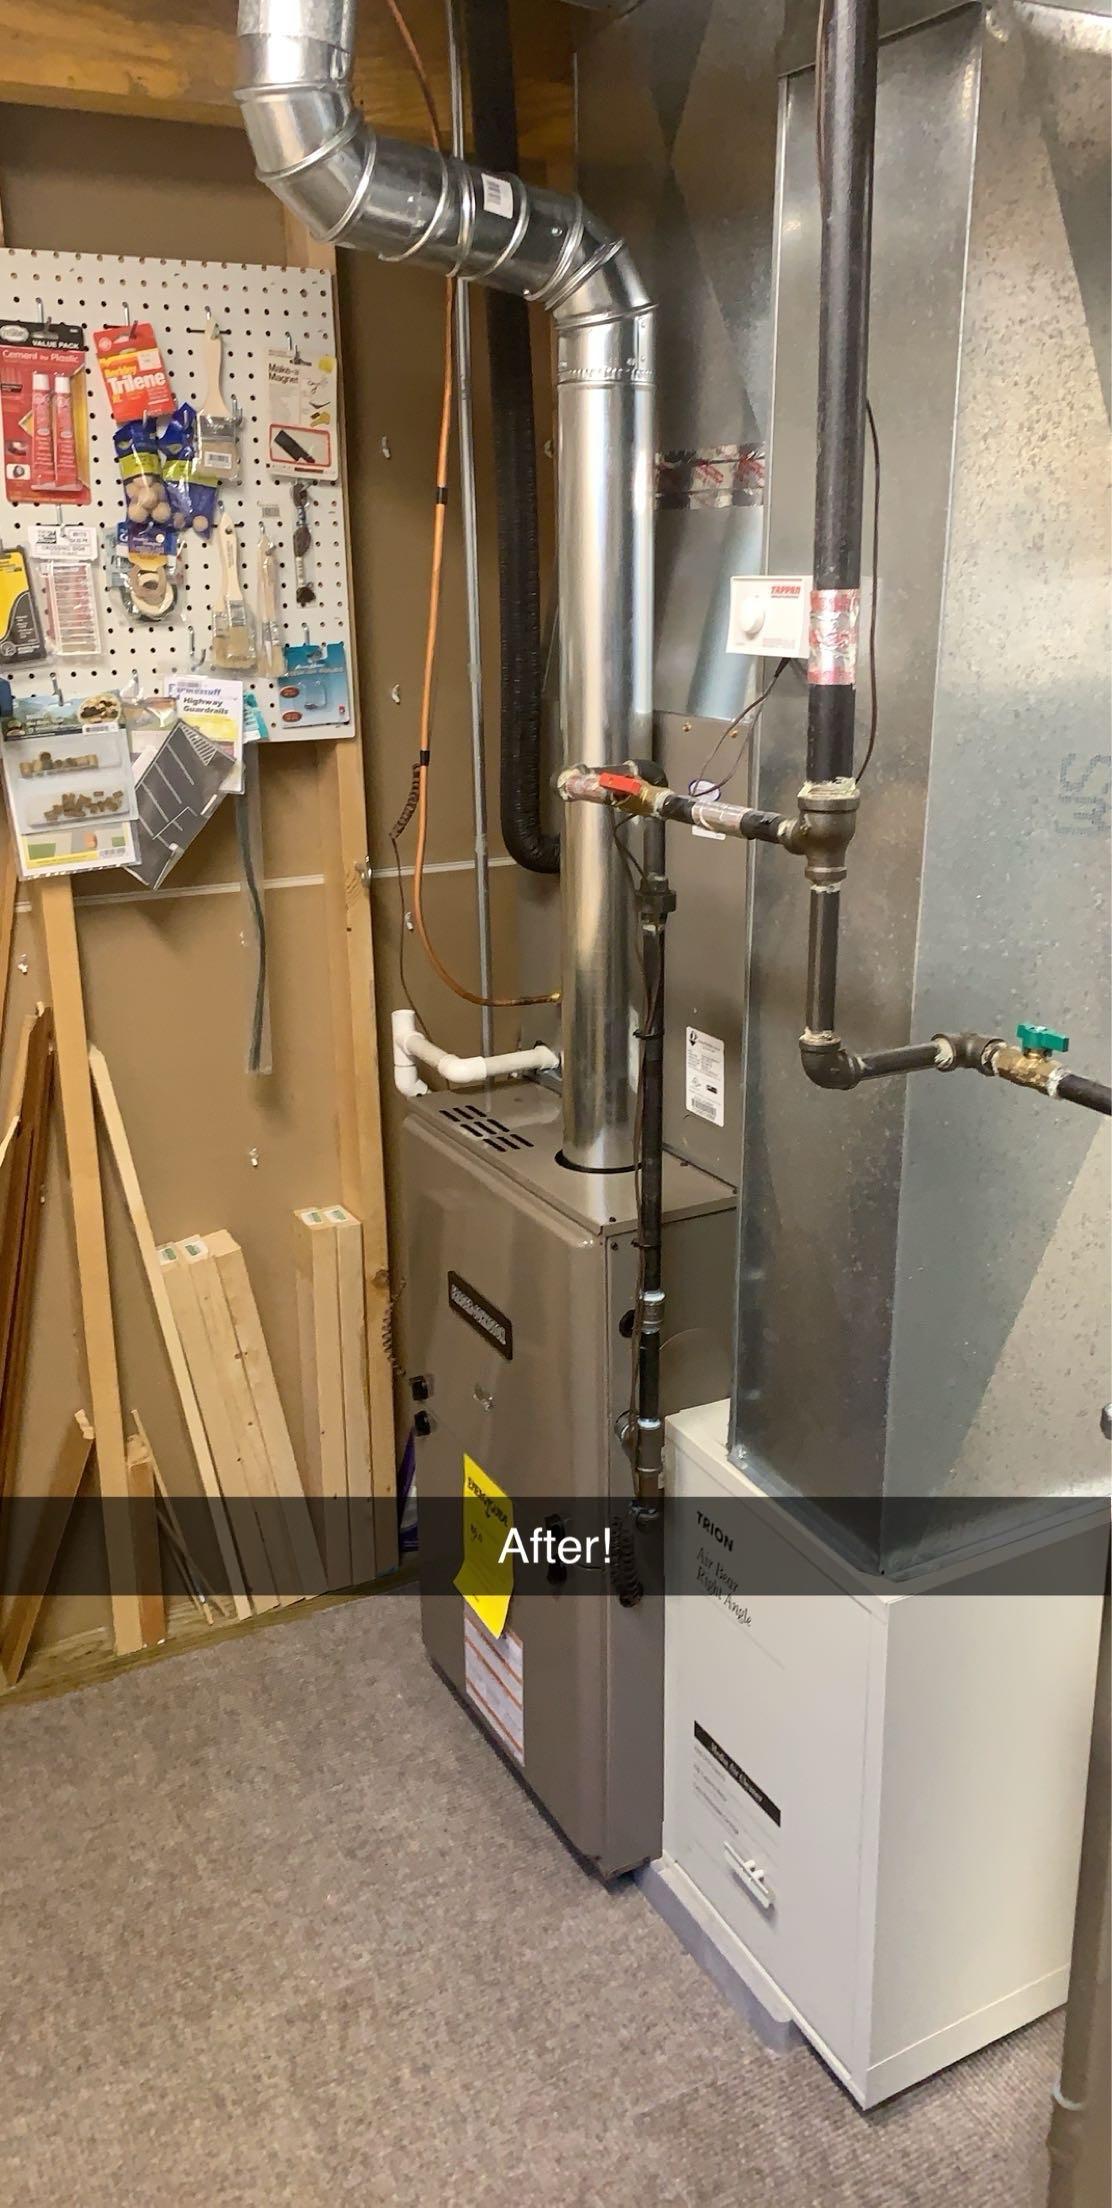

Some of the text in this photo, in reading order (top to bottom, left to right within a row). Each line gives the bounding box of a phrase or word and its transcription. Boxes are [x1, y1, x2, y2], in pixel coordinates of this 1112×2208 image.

[32, 340, 57, 348] VALUE
[2, 350, 38, 360] Cement
[107, 372, 166, 395] Trilene
[770, 585, 801, 595] TAPPAN
[183, 697, 223, 708] Highway
[183, 705, 229, 715] Guardrails
[696, 1510, 734, 1552] TRION
[723, 1593, 752, 1627] Angle
